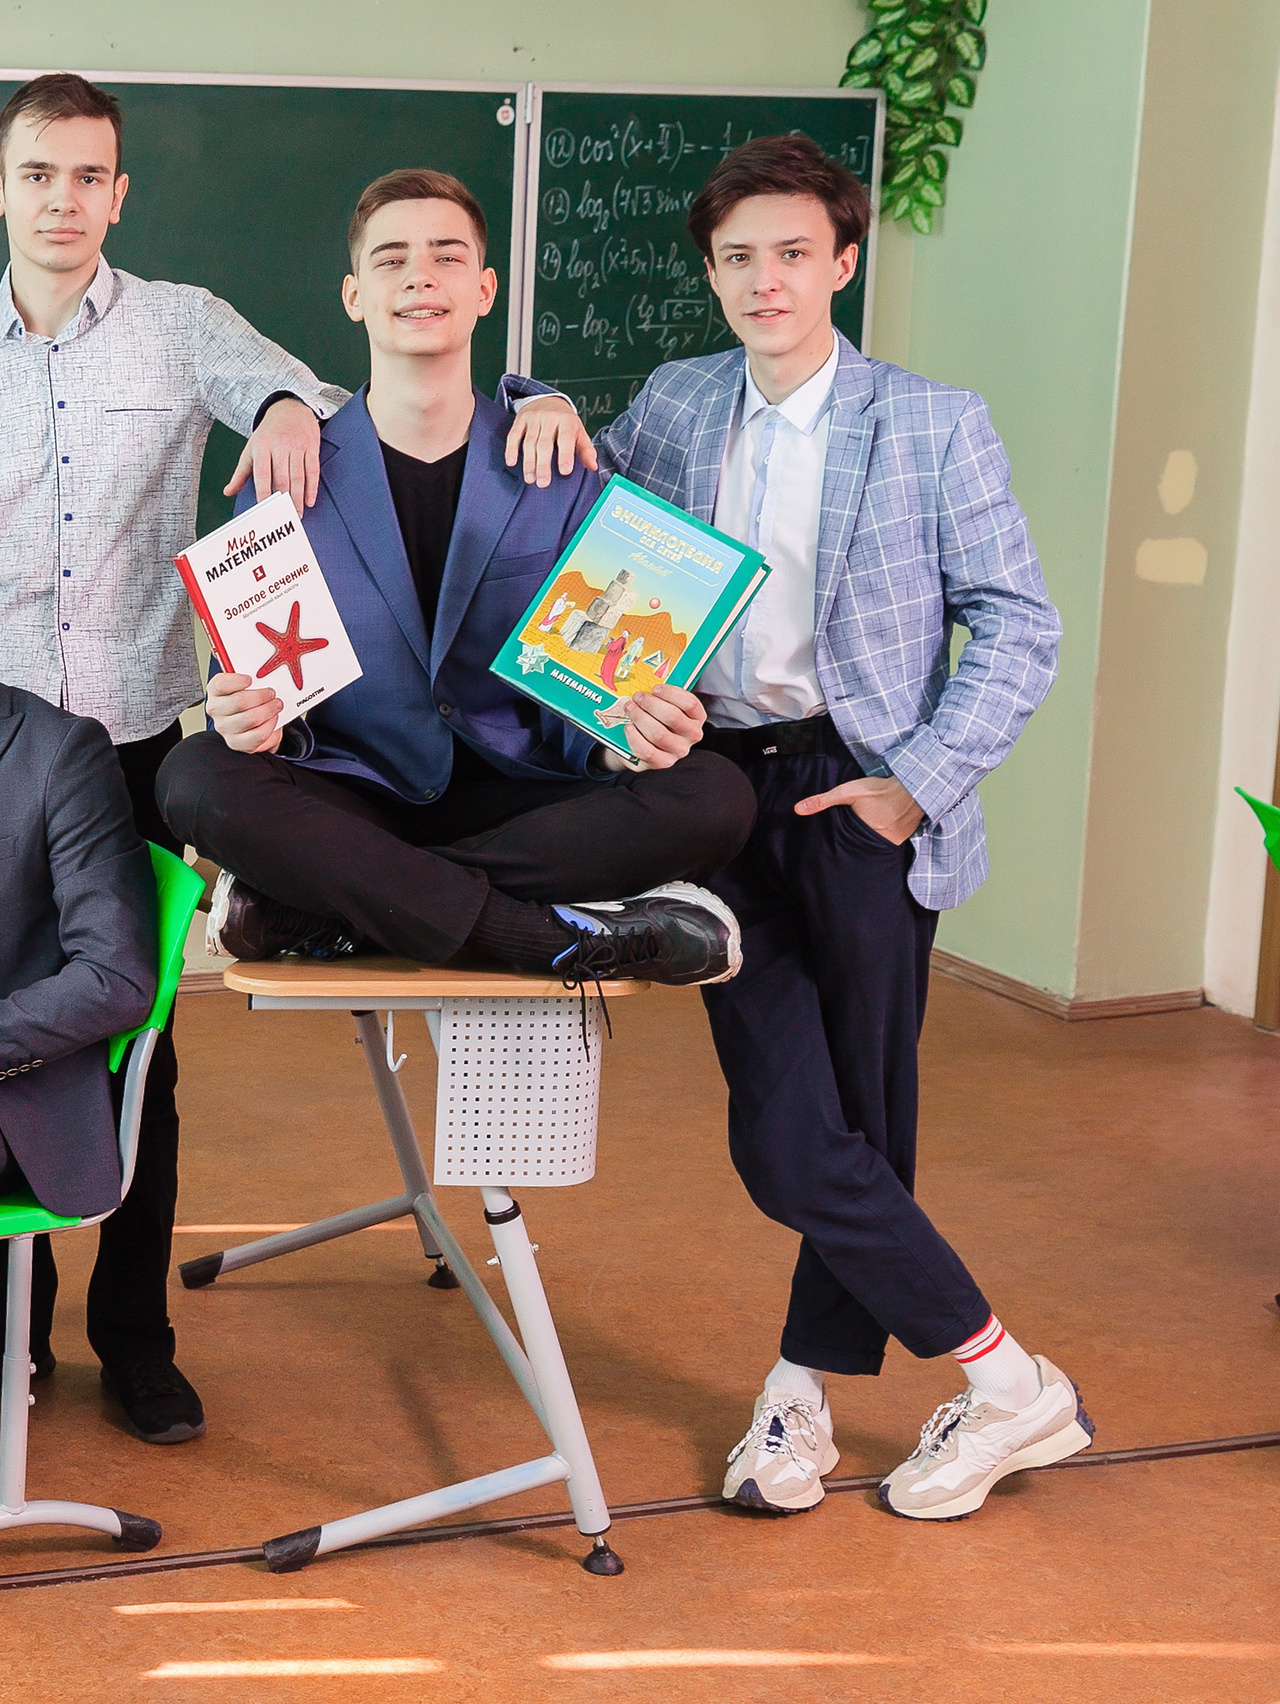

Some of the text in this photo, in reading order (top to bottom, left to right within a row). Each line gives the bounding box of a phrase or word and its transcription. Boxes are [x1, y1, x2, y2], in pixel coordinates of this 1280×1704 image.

[205, 520, 296, 583] МАТЕМАТИКИ
[226, 529, 256, 556] Мир
[610, 504, 725, 575] ЭНЦИКЛОПЕДИЯ
[224, 563, 310, 621] Золотое сечение
[550, 668, 603, 705] МАТЕМАТИКА
